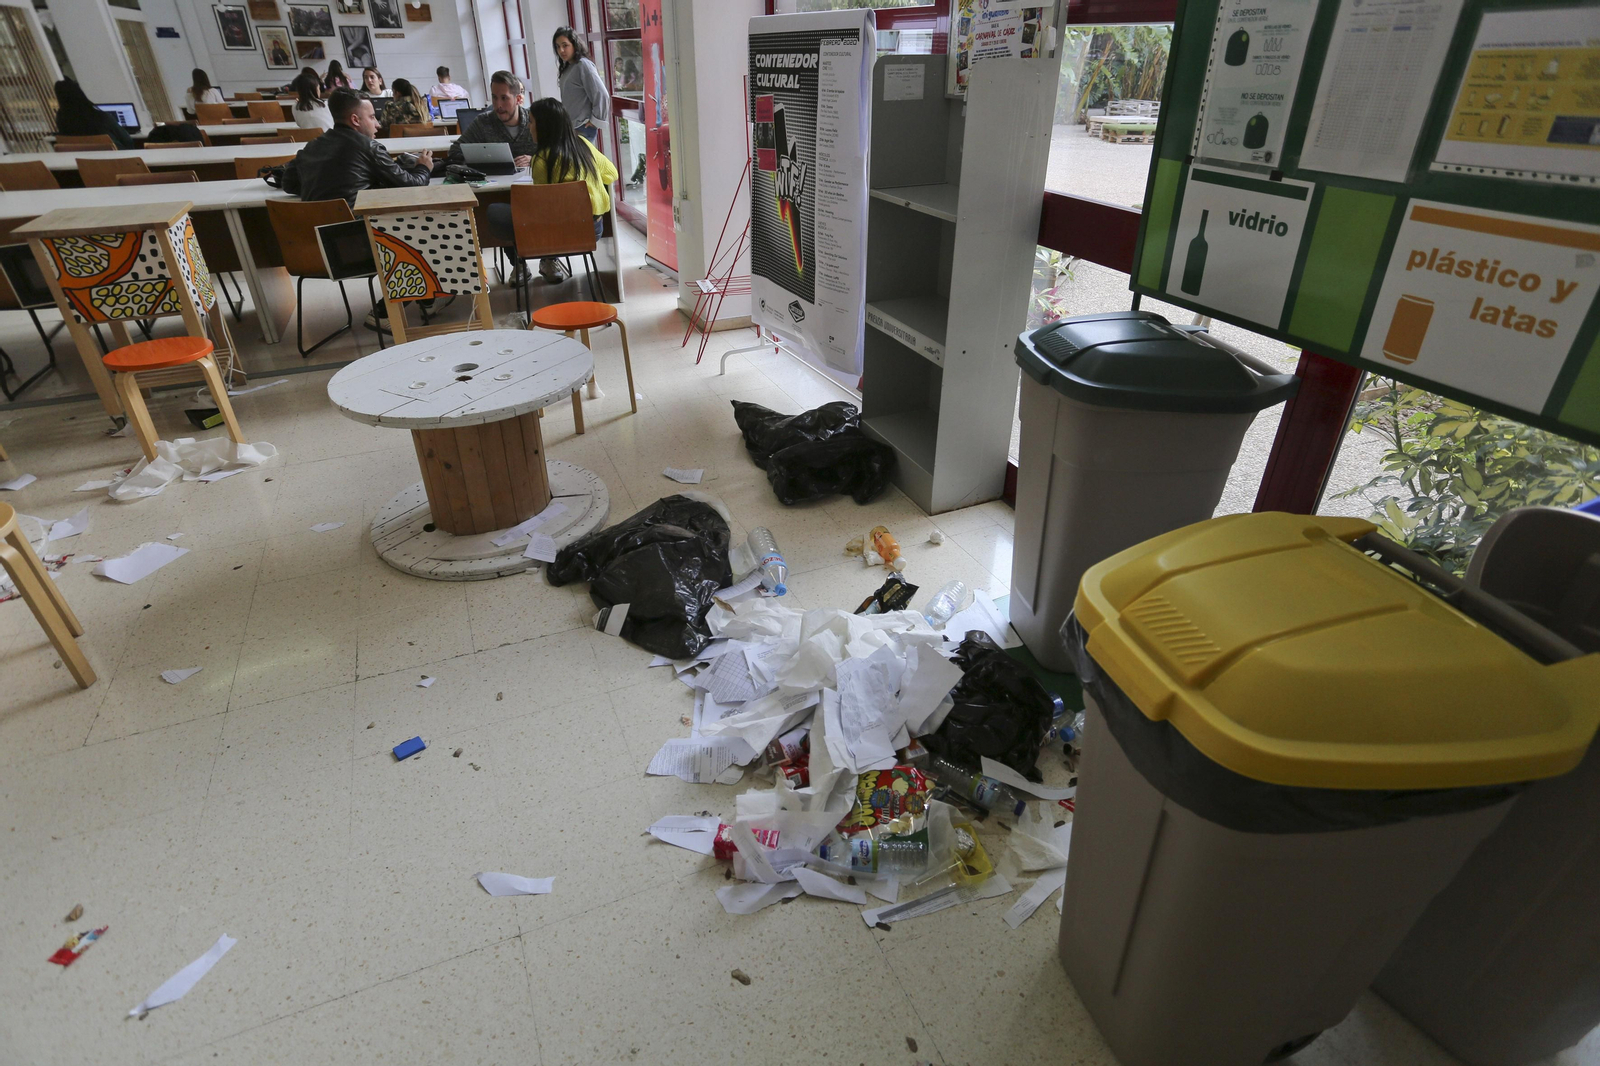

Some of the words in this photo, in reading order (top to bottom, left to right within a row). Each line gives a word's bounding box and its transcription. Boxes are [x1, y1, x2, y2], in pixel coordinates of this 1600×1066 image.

[1232, 9, 1239, 17] SE
[1240, 8, 1267, 16] DEPOSITAN
[975, 30, 996, 40] CARNAVAL
[755, 53, 819, 69] CONTENEDOR
[756, 73, 800, 89] CULTURAL
[1228, 208, 1289, 237] vidrio
[1405, 248, 1541, 292] plástico
[1549, 278, 1579, 304] y
[1468, 296, 1560, 340] latas
